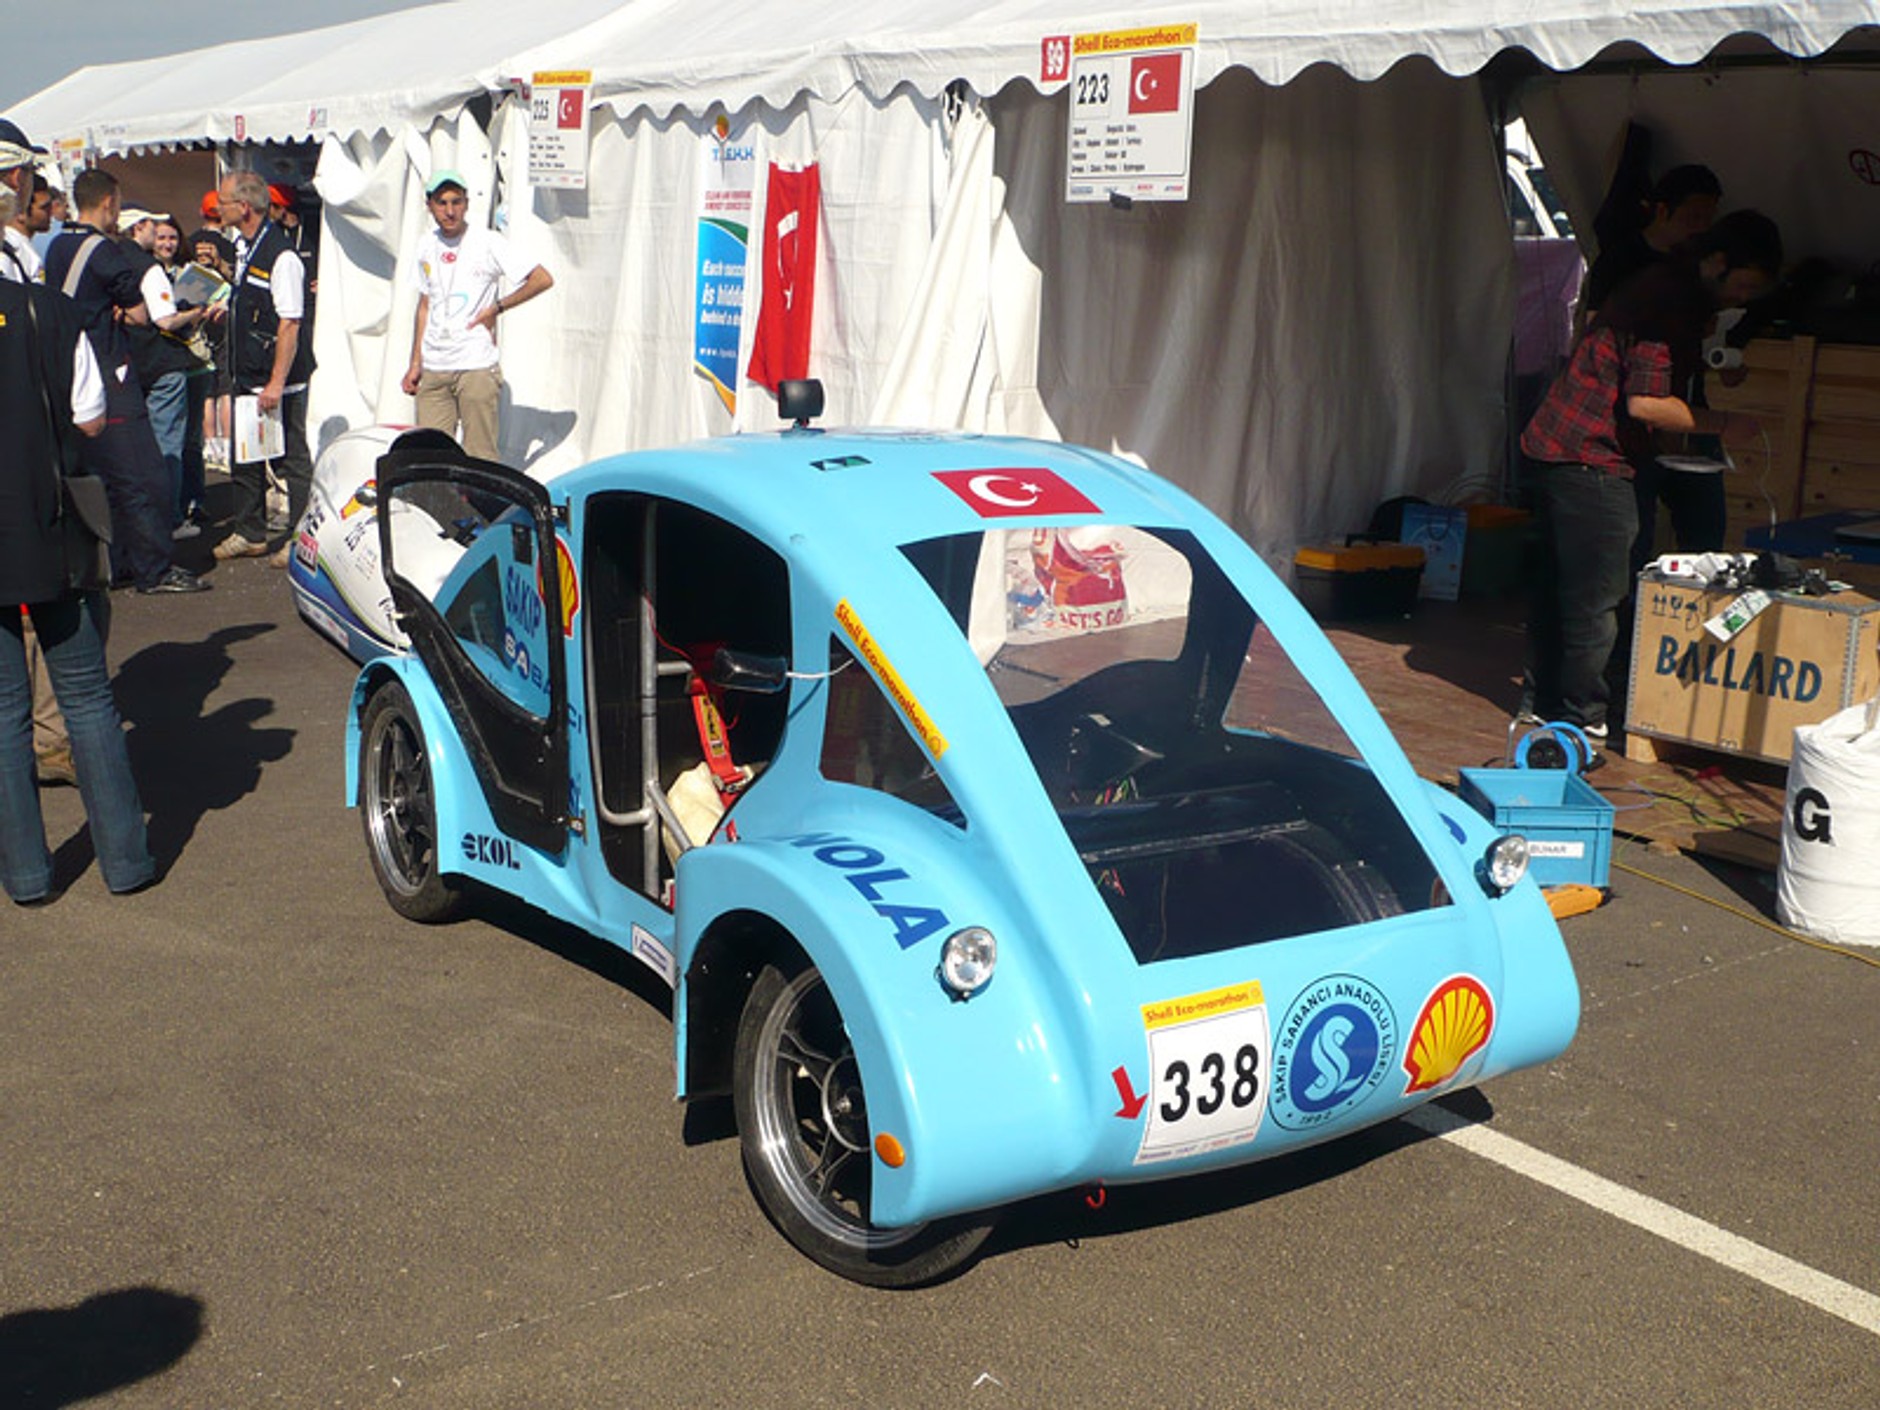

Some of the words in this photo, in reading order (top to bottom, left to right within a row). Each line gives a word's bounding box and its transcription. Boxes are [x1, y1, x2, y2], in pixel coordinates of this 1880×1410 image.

[1074, 34, 1100, 54] Shell
[1102, 27, 1181, 50] Eco-marathon
[1076, 73, 1110, 105] 223
[837, 603, 863, 643] Shell
[860, 638, 928, 730] Eco-marathon
[1655, 634, 1823, 704] BALLARD
[1793, 787, 1835, 844] G
[1145, 1006, 1174, 1023] Shell
[1175, 992, 1250, 1017] Eco-marathon
[1275, 1054, 1288, 1103] SAKIP
[1282, 986, 1332, 1049] SABANCI
[1335, 983, 1391, 1031] ANADOLU
[1160, 1043, 1260, 1123] 338
